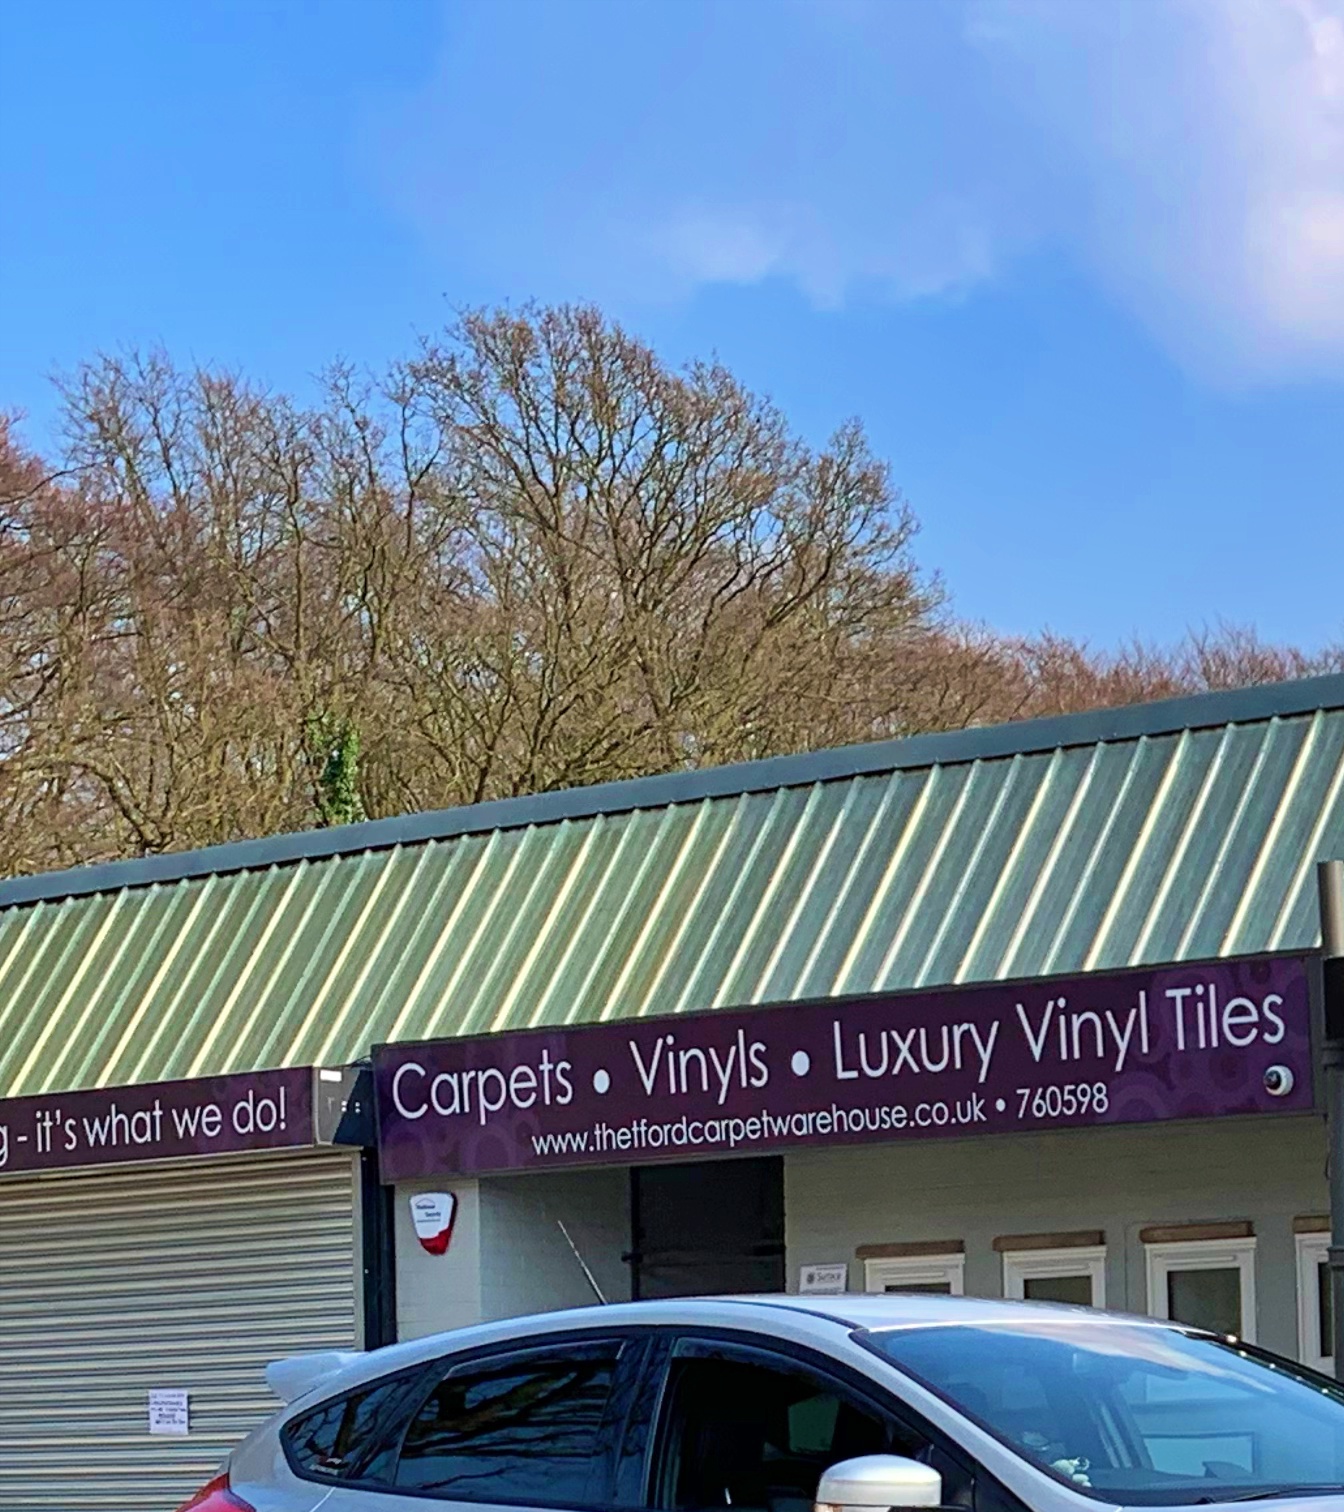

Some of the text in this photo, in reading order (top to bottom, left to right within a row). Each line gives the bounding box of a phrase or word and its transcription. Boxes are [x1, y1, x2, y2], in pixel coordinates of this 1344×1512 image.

[392, 983, 1285, 1126] Carpets Vinyls Luxury Vinyl Tiles
[35, 1109, 77, 1153] it's
[82, 1099, 164, 1147] what
[171, 1104, 222, 1139] we
[232, 1086, 286, 1134] do!
[531, 1081, 1109, 1156] www.thetfordcarpetwarehouse.co.uk 760598
